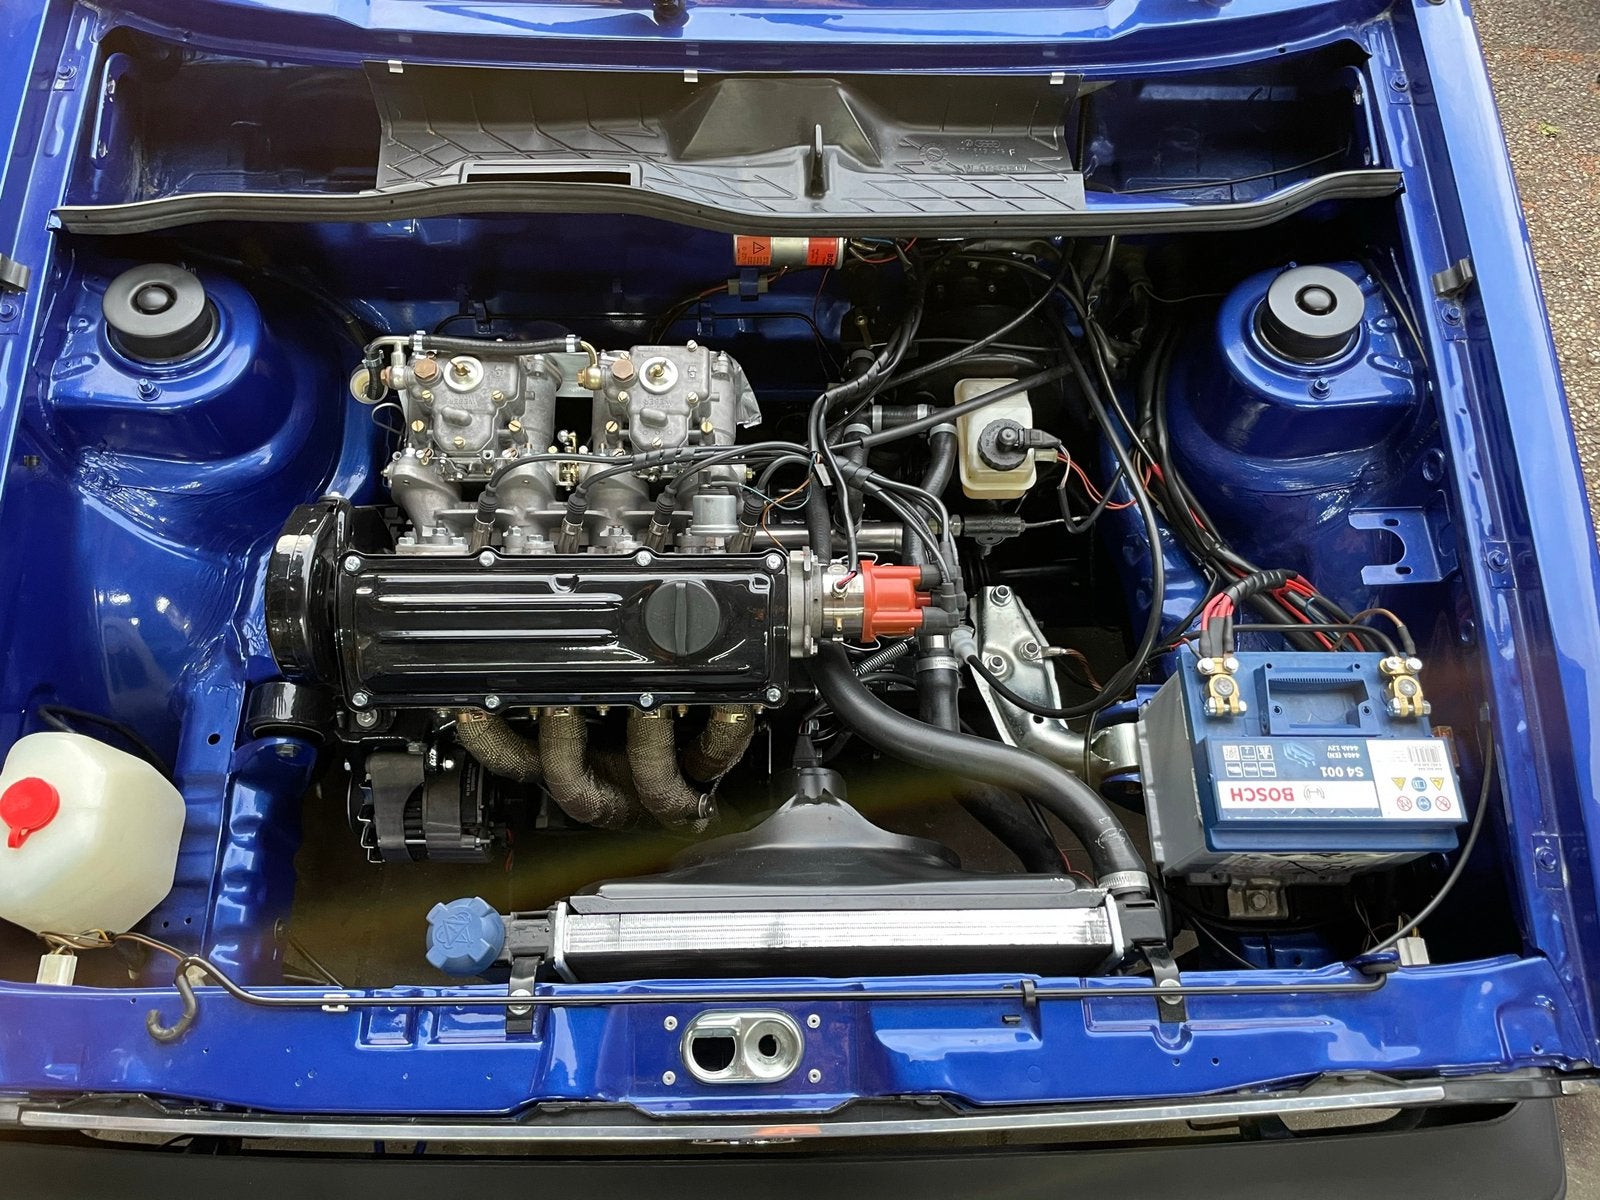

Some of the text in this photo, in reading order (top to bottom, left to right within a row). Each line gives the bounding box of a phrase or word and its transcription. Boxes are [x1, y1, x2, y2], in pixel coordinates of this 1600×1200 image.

[1320, 766, 1364, 778] S4 001
[1230, 787, 1295, 802] BOSCH
